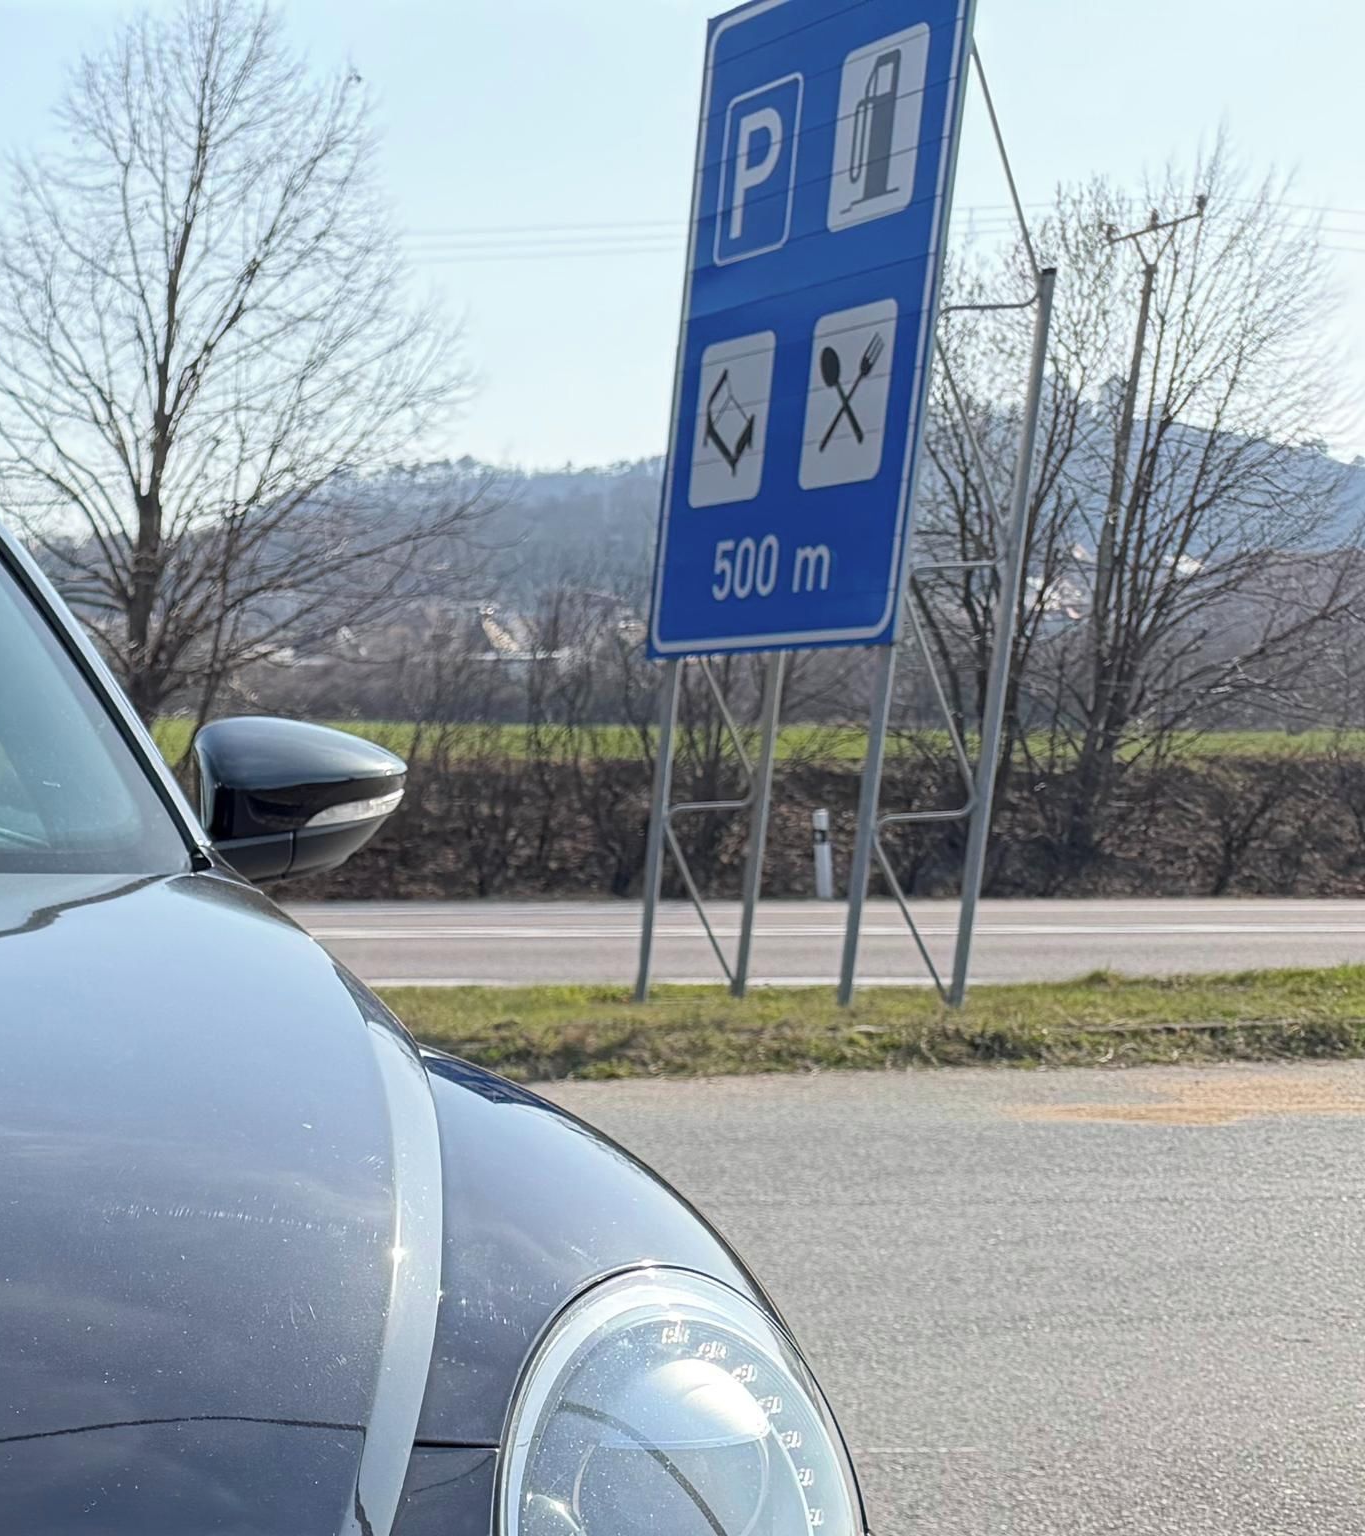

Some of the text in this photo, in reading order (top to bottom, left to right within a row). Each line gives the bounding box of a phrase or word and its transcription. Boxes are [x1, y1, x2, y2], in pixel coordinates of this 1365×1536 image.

[730, 107, 782, 240] P
[712, 534, 830, 601] 500 m
